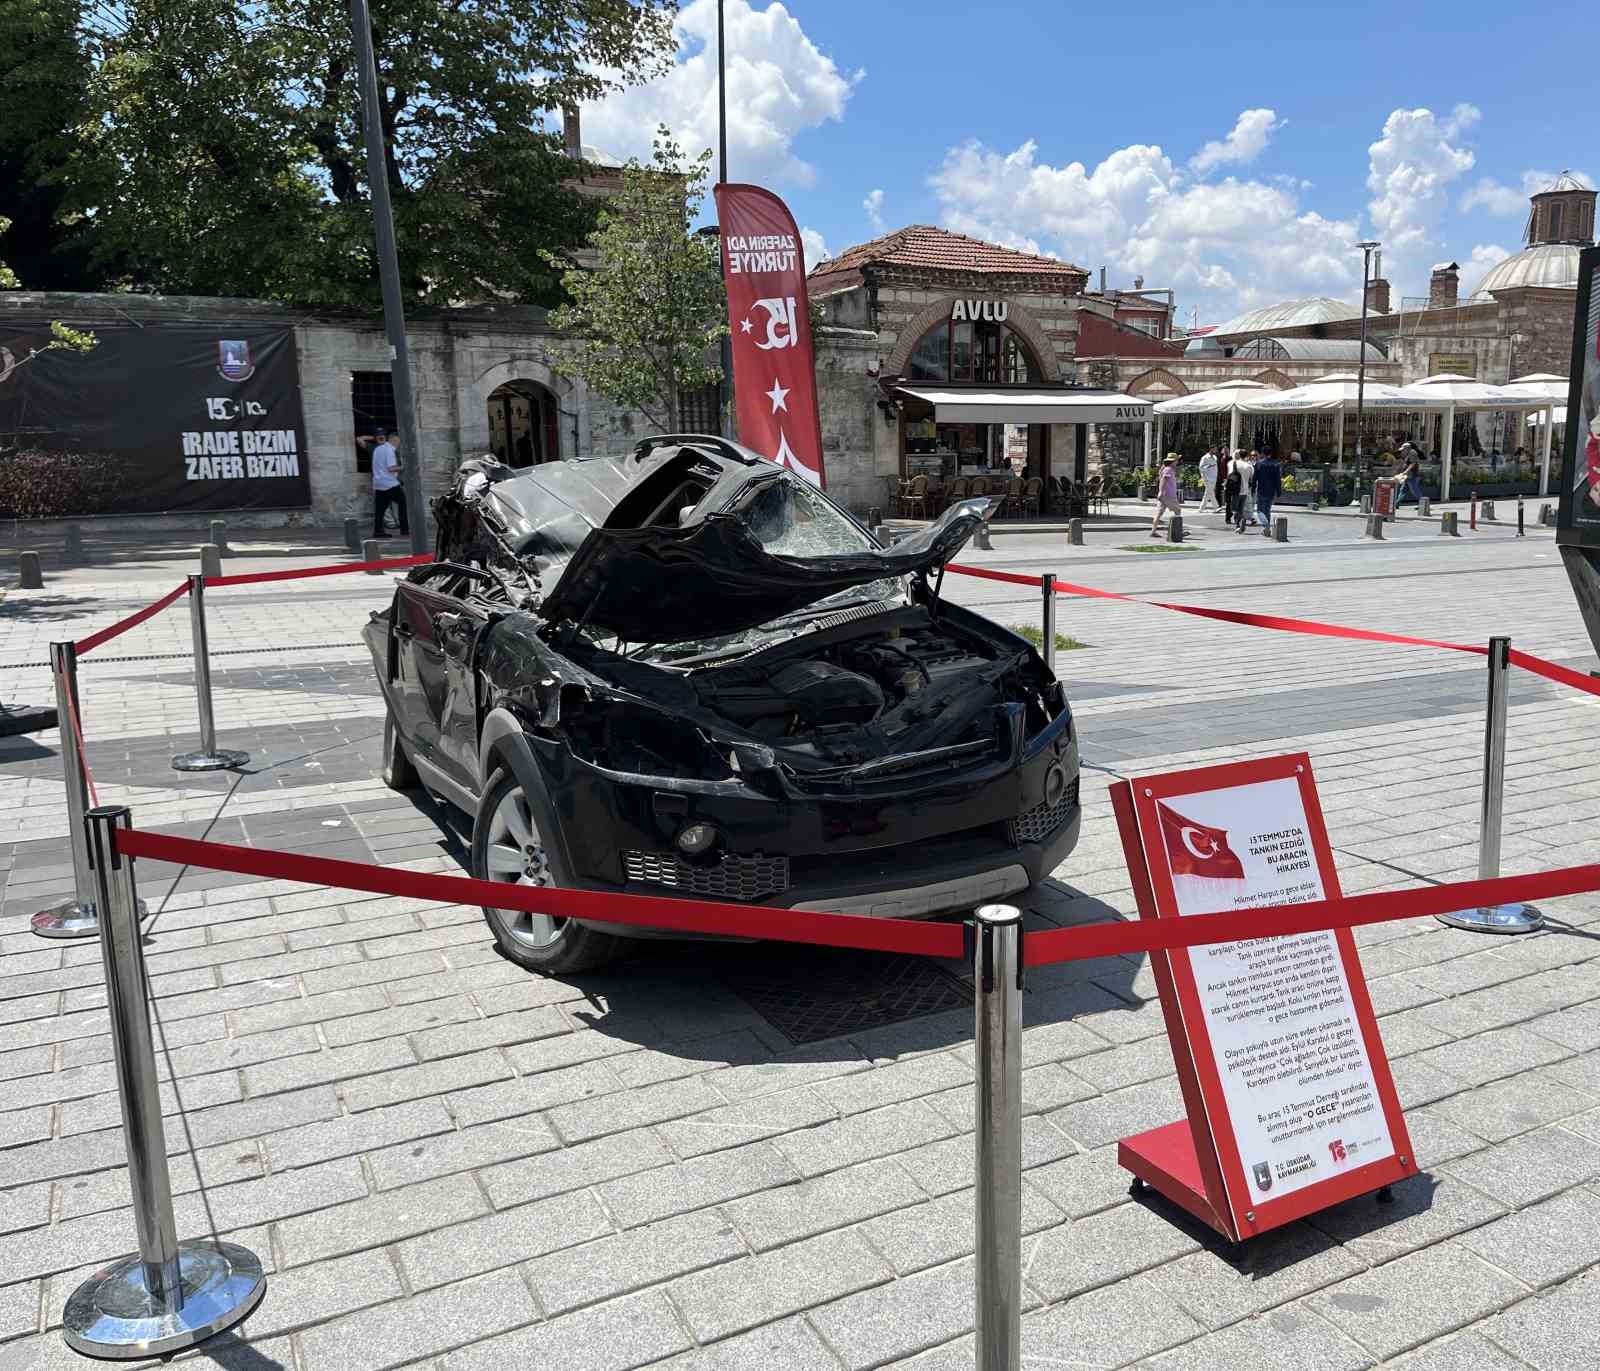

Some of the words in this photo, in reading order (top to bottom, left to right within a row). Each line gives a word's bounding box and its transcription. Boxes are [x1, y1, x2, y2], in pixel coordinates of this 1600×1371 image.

[951, 299, 1008, 321] AVLU
[1115, 406, 1146, 418] AVLU
[181, 431, 240, 455] İRADE
[242, 430, 297, 453] BİZİM
[184, 456, 244, 480] ZAFER
[246, 454, 299, 478] BİZİM
[1249, 836, 1257, 844] 15
[1257, 828, 1302, 842] TEMMUZ'DA
[1249, 844, 1279, 856] TANKIN
[1280, 838, 1305, 850] EZDİĞİ
[1267, 855, 1278, 864] BU
[1279, 849, 1307, 862] ARACIN
[1234, 895, 1257, 905] Hikmet
[1258, 890, 1279, 899] Harput
[1286, 886, 1299, 895] gece
[1237, 952, 1252, 960] Tank
[1253, 947, 1275, 957] üzerine
[1277, 941, 1300, 953] gelmeye
[1208, 982, 1227, 992] Ancak
[1228, 977, 1246, 986] tankın
[1274, 966, 1291, 975] aracın
[1293, 959, 1320, 970] camından
[1226, 988, 1249, 999] Hikmet
[1250, 982, 1272, 992] Harput
[1285, 975, 1299, 983] anda
[1300, 968, 1320, 979] kendini
[1211, 1003, 1230, 1015] atarak
[1276, 988, 1290, 997] Tank
[1288, 996, 1302, 1006] Kolu
[1322, 986, 1342, 996] Harput
[1275, 1012, 1288, 1023] gece
[1289, 1005, 1318, 1016] hastaneye
[1225, 1049, 1244, 1059] Olayın
[1270, 1037, 1284, 1045] uzun
[1285, 1033, 1299, 1041] süre
[1300, 1027, 1317, 1037] evden
[1258, 1050, 1278, 1061] destek
[1336, 1027, 1353, 1040] geceyi
[1318, 1045, 1331, 1056] Çok
[1247, 1075, 1276, 1088] Kardeşim
[1258, 1115, 1267, 1123] Bu
[1268, 1111, 1281, 1120] araç
[1283, 1106, 1290, 1114] 15
[1290, 1099, 1315, 1112] Temmuz
[1316, 1091, 1340, 1104] Derneği
[1289, 1116, 1302, 1125] olup
[1272, 1124, 1314, 1143] unutturmamak
[1316, 1120, 1326, 1128] için
